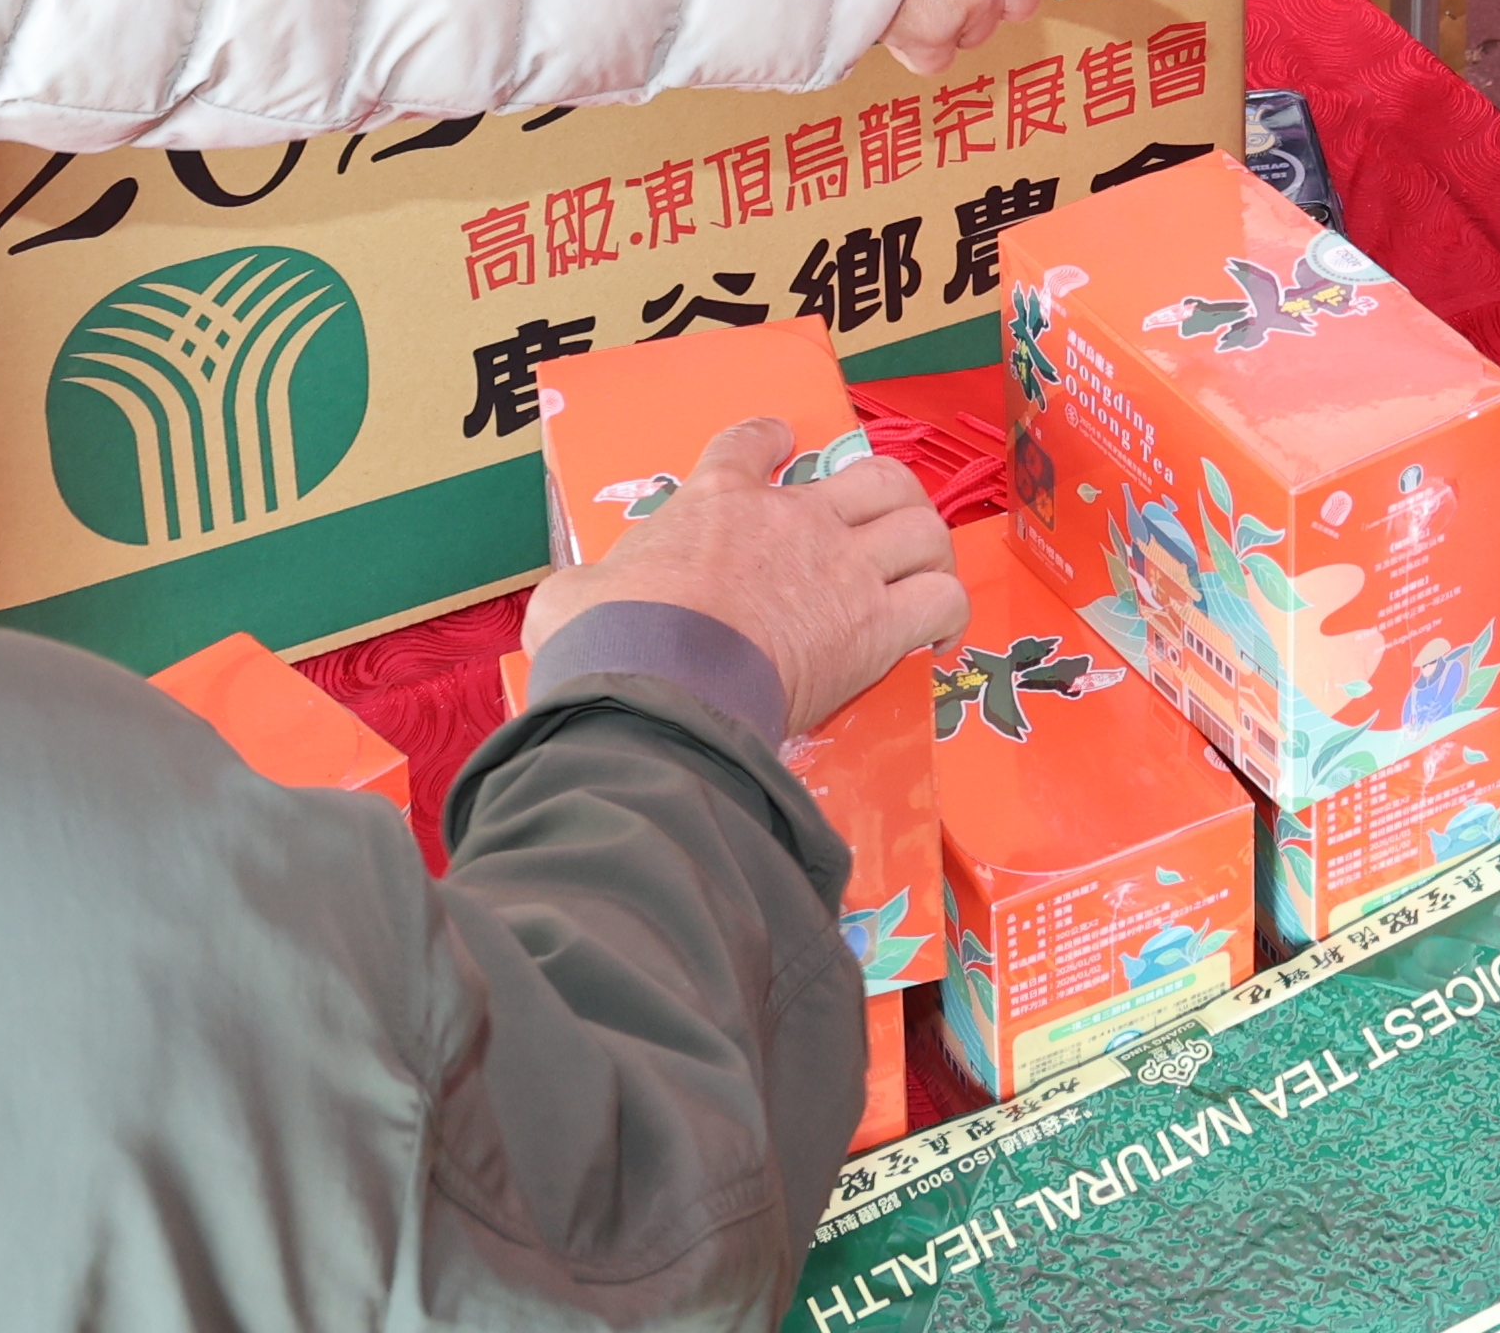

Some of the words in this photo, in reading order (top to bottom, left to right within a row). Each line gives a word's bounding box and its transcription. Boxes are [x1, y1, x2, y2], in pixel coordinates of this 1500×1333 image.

[1065, 345, 1156, 446] Dongding
[1065, 373, 1132, 450] Oolong
[1139, 438, 1175, 486] Tea
[1120, 1040, 1151, 1061] YING
[1161, 1020, 1197, 1046] GUANG
[1249, 1048, 1358, 1118] TEA
[905, 1167, 955, 1202] 9001
[956, 1146, 997, 1175] ISO
[1017, 1108, 1255, 1235] NATURAL
[806, 1213, 1018, 1333] HEALTH
